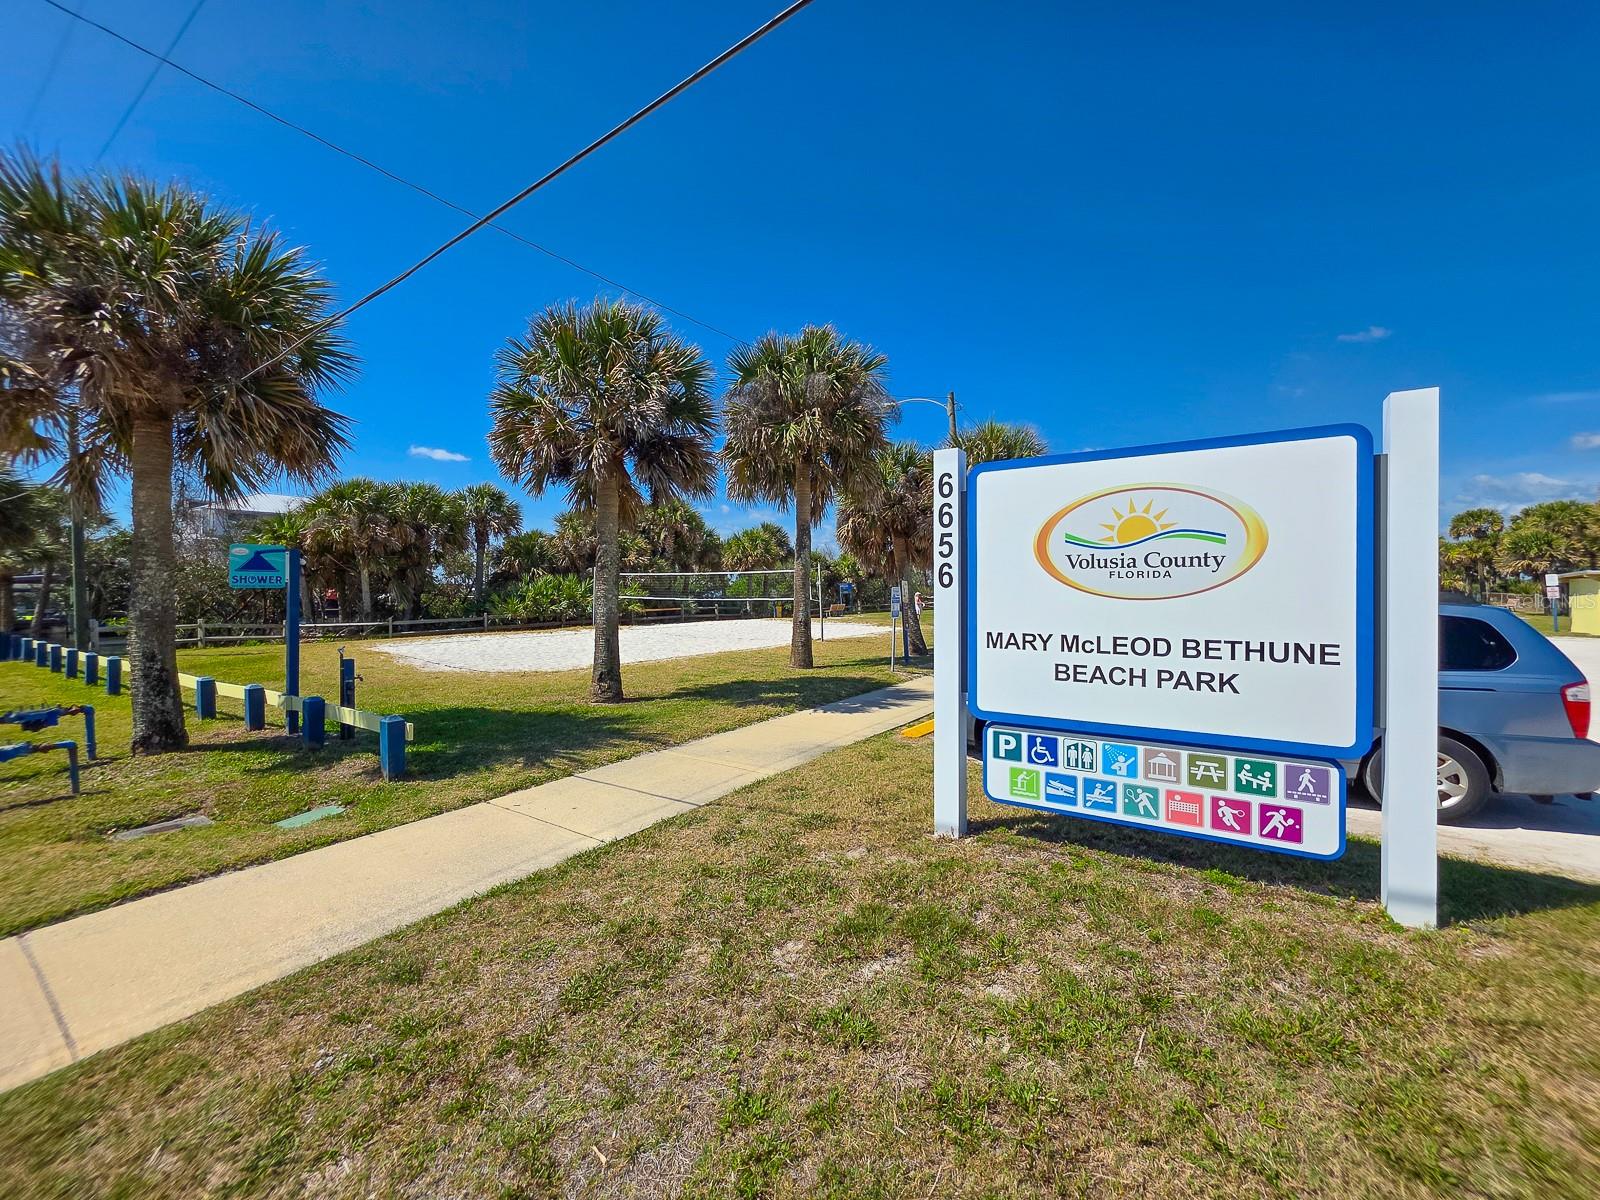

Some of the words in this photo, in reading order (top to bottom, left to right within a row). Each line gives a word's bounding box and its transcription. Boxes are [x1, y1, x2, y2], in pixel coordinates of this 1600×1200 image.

[938, 472, 954, 589] 6656
[1064, 551, 1138, 570] Volusia
[1143, 550, 1226, 573] County
[231, 575, 283, 584] SHOWER
[1109, 570, 1172, 579] FLORIDA
[986, 631, 1054, 652] MARY
[1060, 634, 1172, 657] McLEOD
[1182, 638, 1341, 666] BETHUNE
[1054, 663, 1147, 688] BEACH
[1157, 669, 1241, 695] PARK
[999, 734, 1017, 758] P
